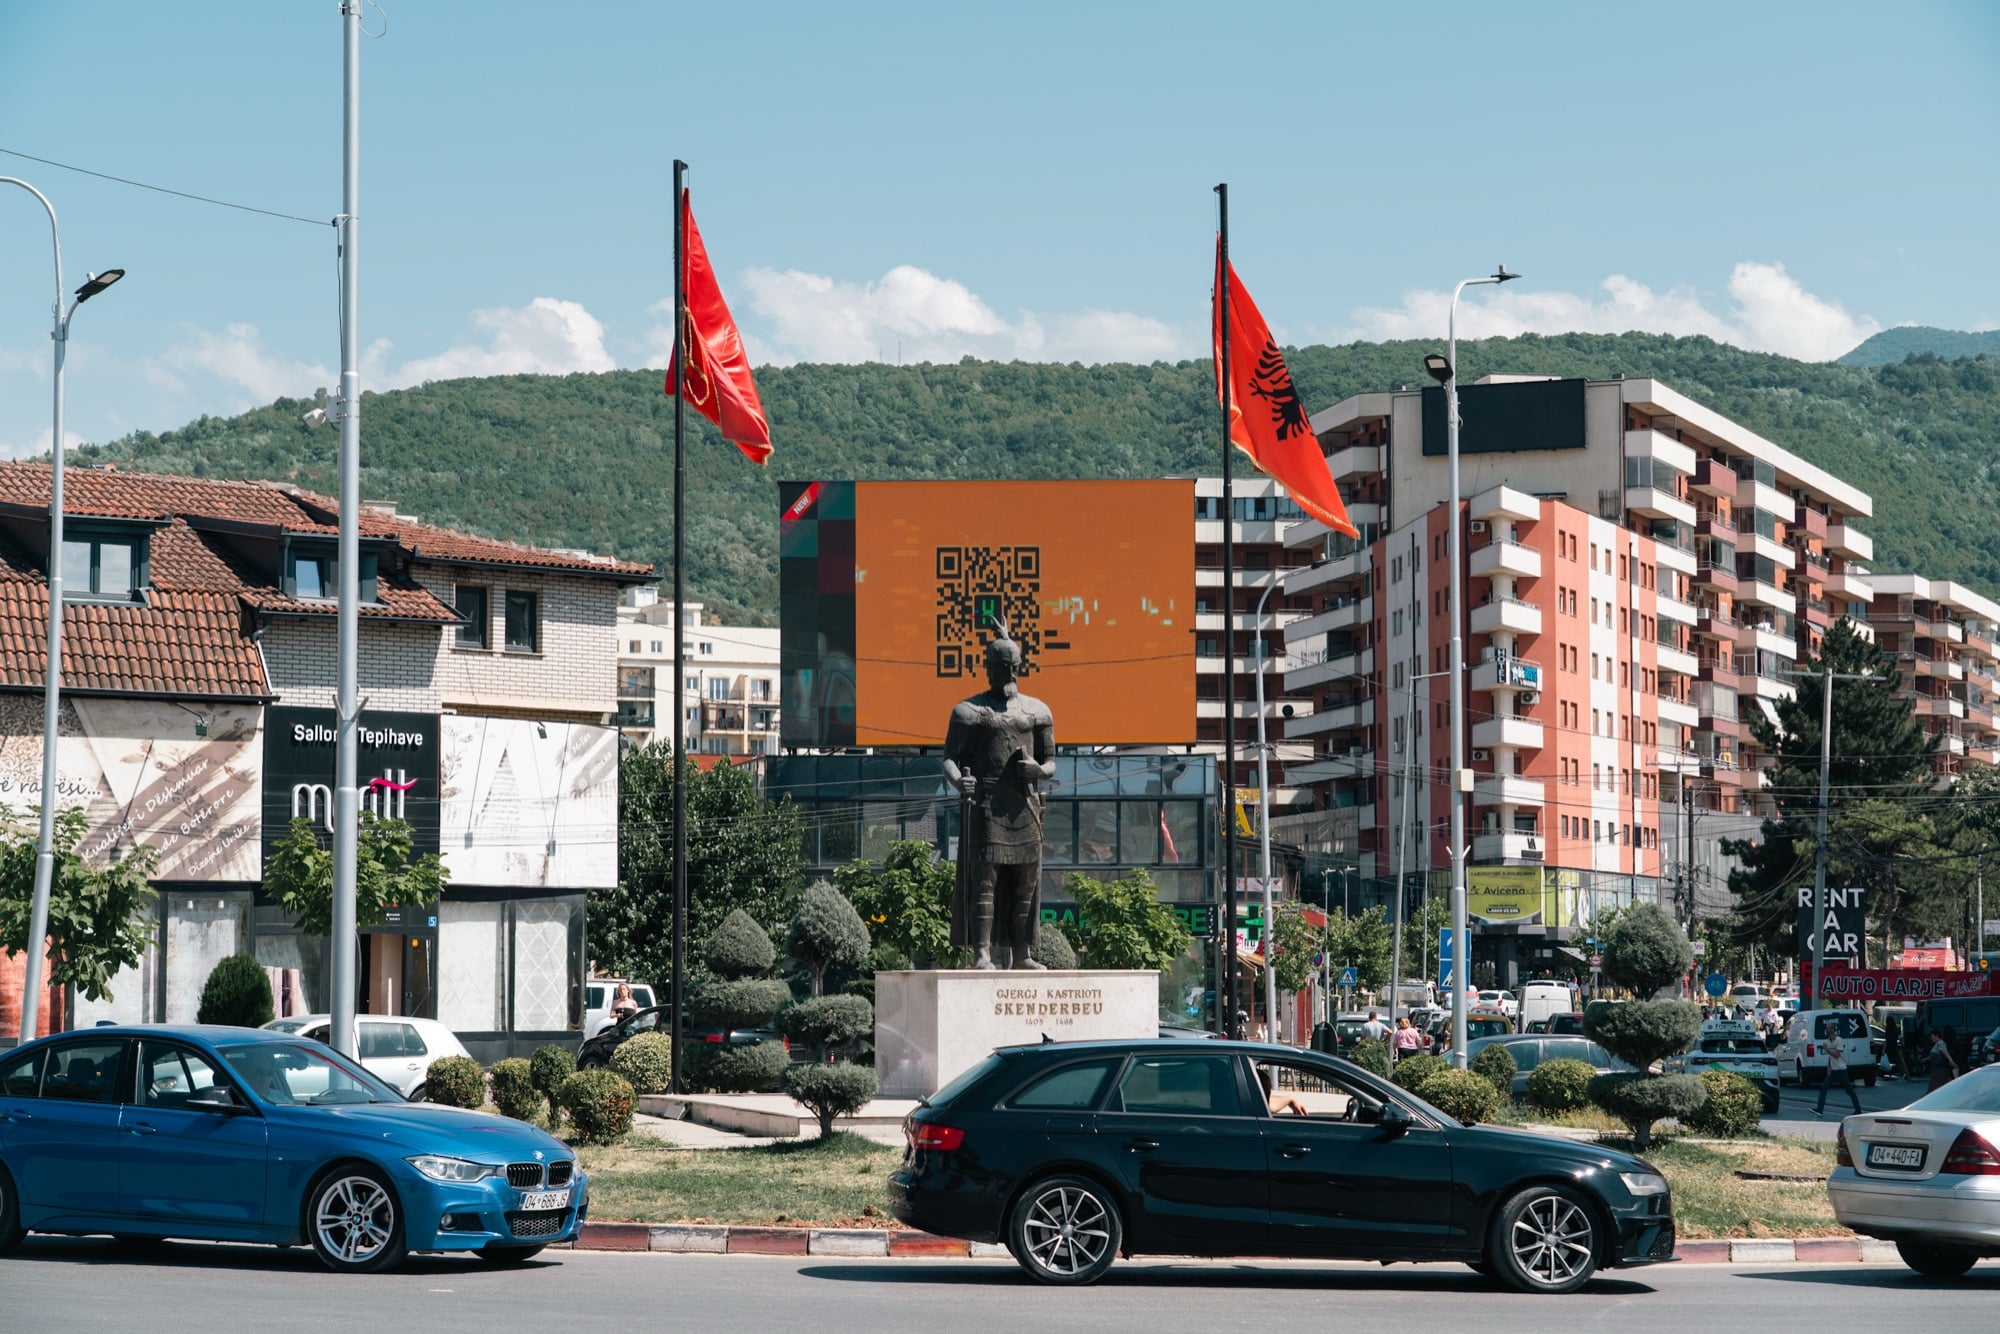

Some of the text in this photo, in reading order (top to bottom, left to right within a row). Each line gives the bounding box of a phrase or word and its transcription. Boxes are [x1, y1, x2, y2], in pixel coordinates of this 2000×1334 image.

[793, 496, 809, 514] NEW
[1497, 648, 1506, 683] HOTEL
[358, 727, 423, 748] Tepihave
[81, 816, 135, 863] Kualitet
[146, 758, 210, 813] Dëshmuar
[180, 788, 235, 835] Botërore
[188, 824, 250, 877] Dizajne Unike
[1824, 910, 1841, 930] A
[996, 989, 1102, 1000] GJERGJ KASTRIOTI
[1822, 976, 1876, 995] AUTO
[1881, 977, 1946, 997] LARJE
[994, 1002, 1103, 1016] SKENDERBEU
